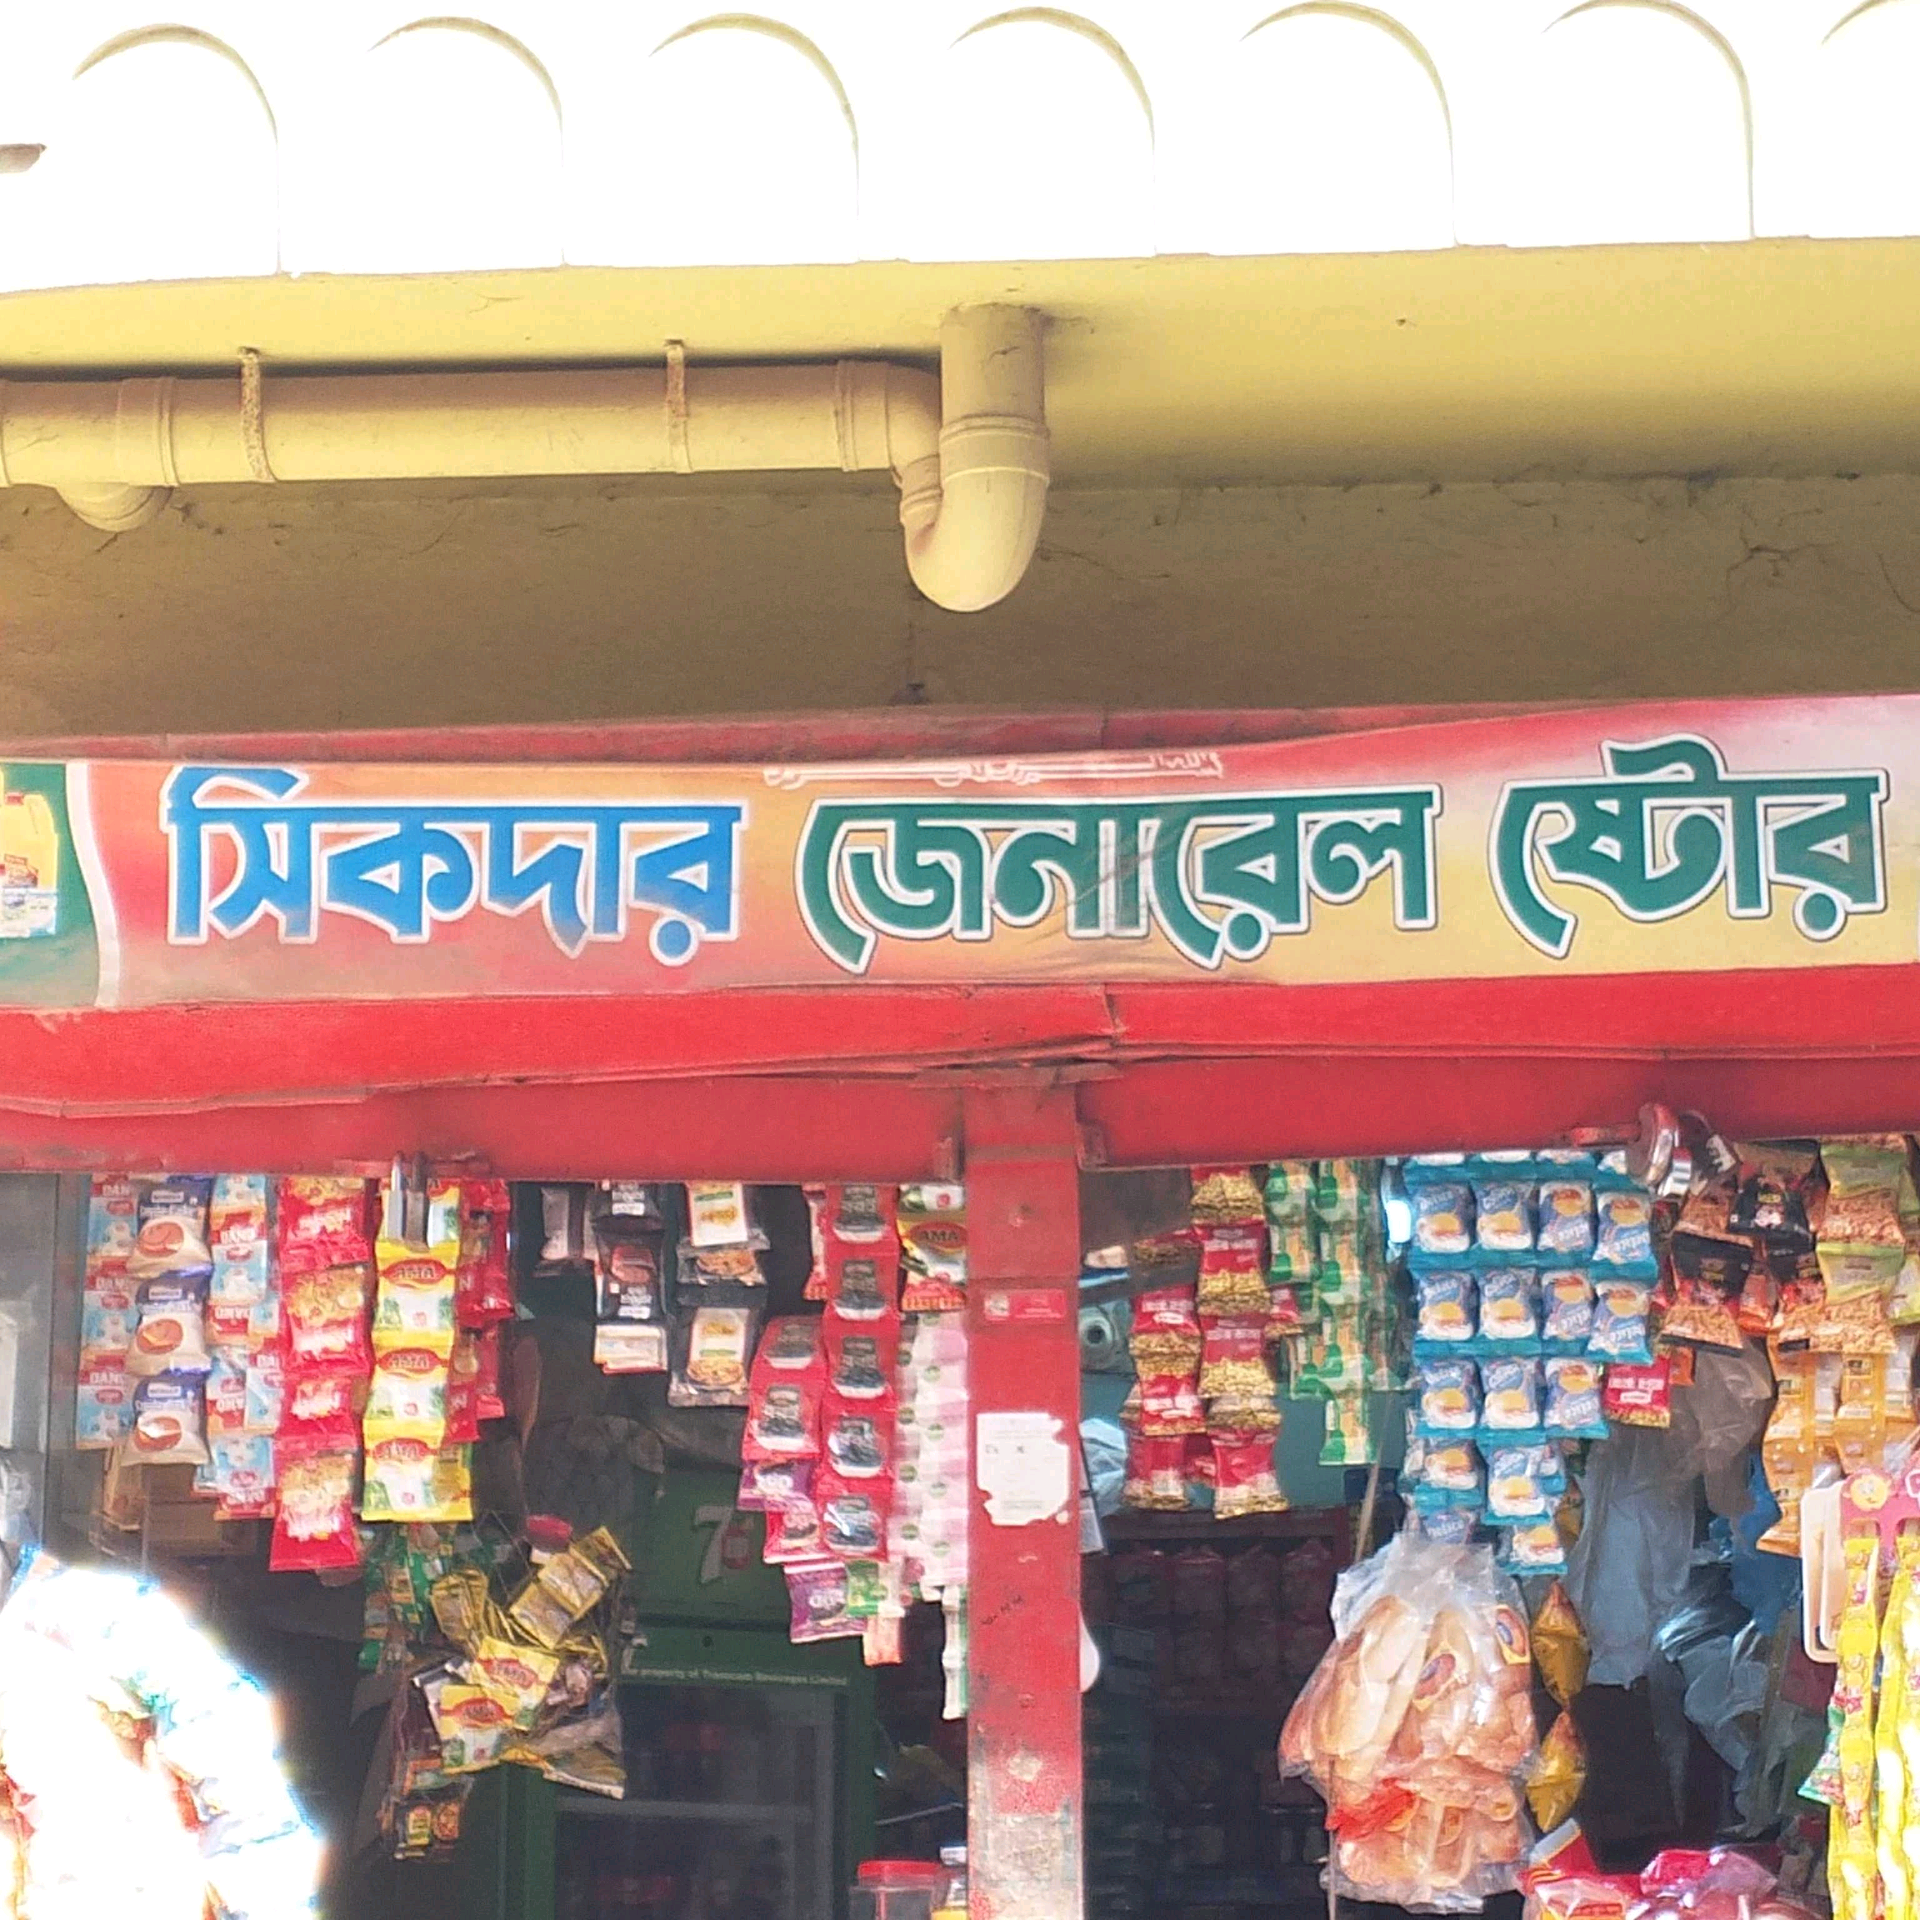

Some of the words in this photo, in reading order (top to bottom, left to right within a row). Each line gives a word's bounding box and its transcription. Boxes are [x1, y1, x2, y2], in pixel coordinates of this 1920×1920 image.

[160, 763, 749, 966] সিকদার
[795, 784, 1442, 974] জেনারেল
[1488, 733, 1888, 958] ষ্টোর
